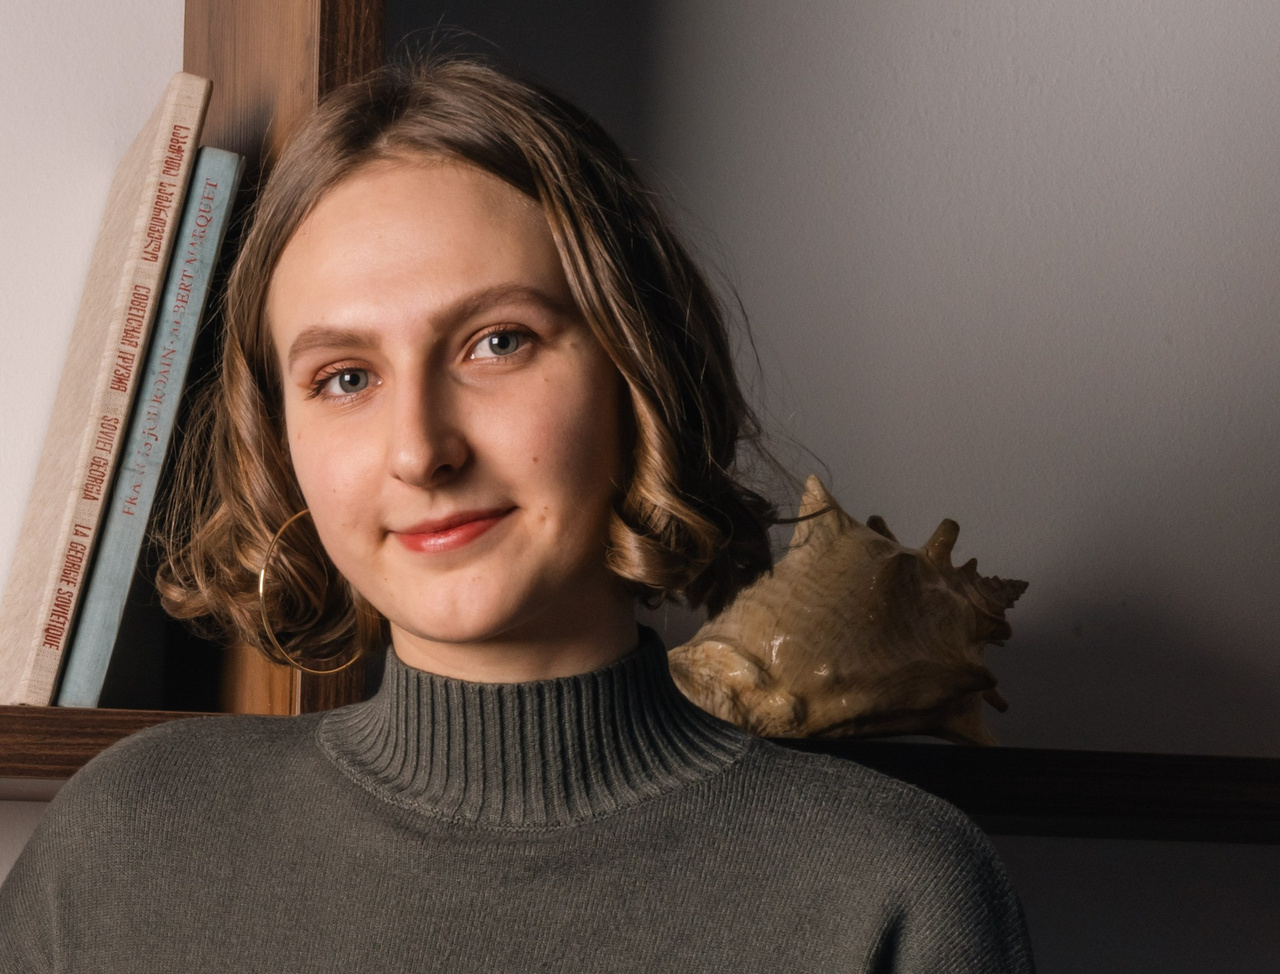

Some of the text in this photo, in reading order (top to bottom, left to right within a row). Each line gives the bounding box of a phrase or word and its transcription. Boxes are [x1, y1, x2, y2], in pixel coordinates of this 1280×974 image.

[140, 180, 177, 264] საქართველო
[109, 284, 152, 393] СОВЕТСКАЯ ГРУЗИЯ
[81, 414, 120, 503] SOVIET GEORGIA
[72, 523, 91, 539] LA
[41, 587, 76, 651] SOVIÉTIQUE
